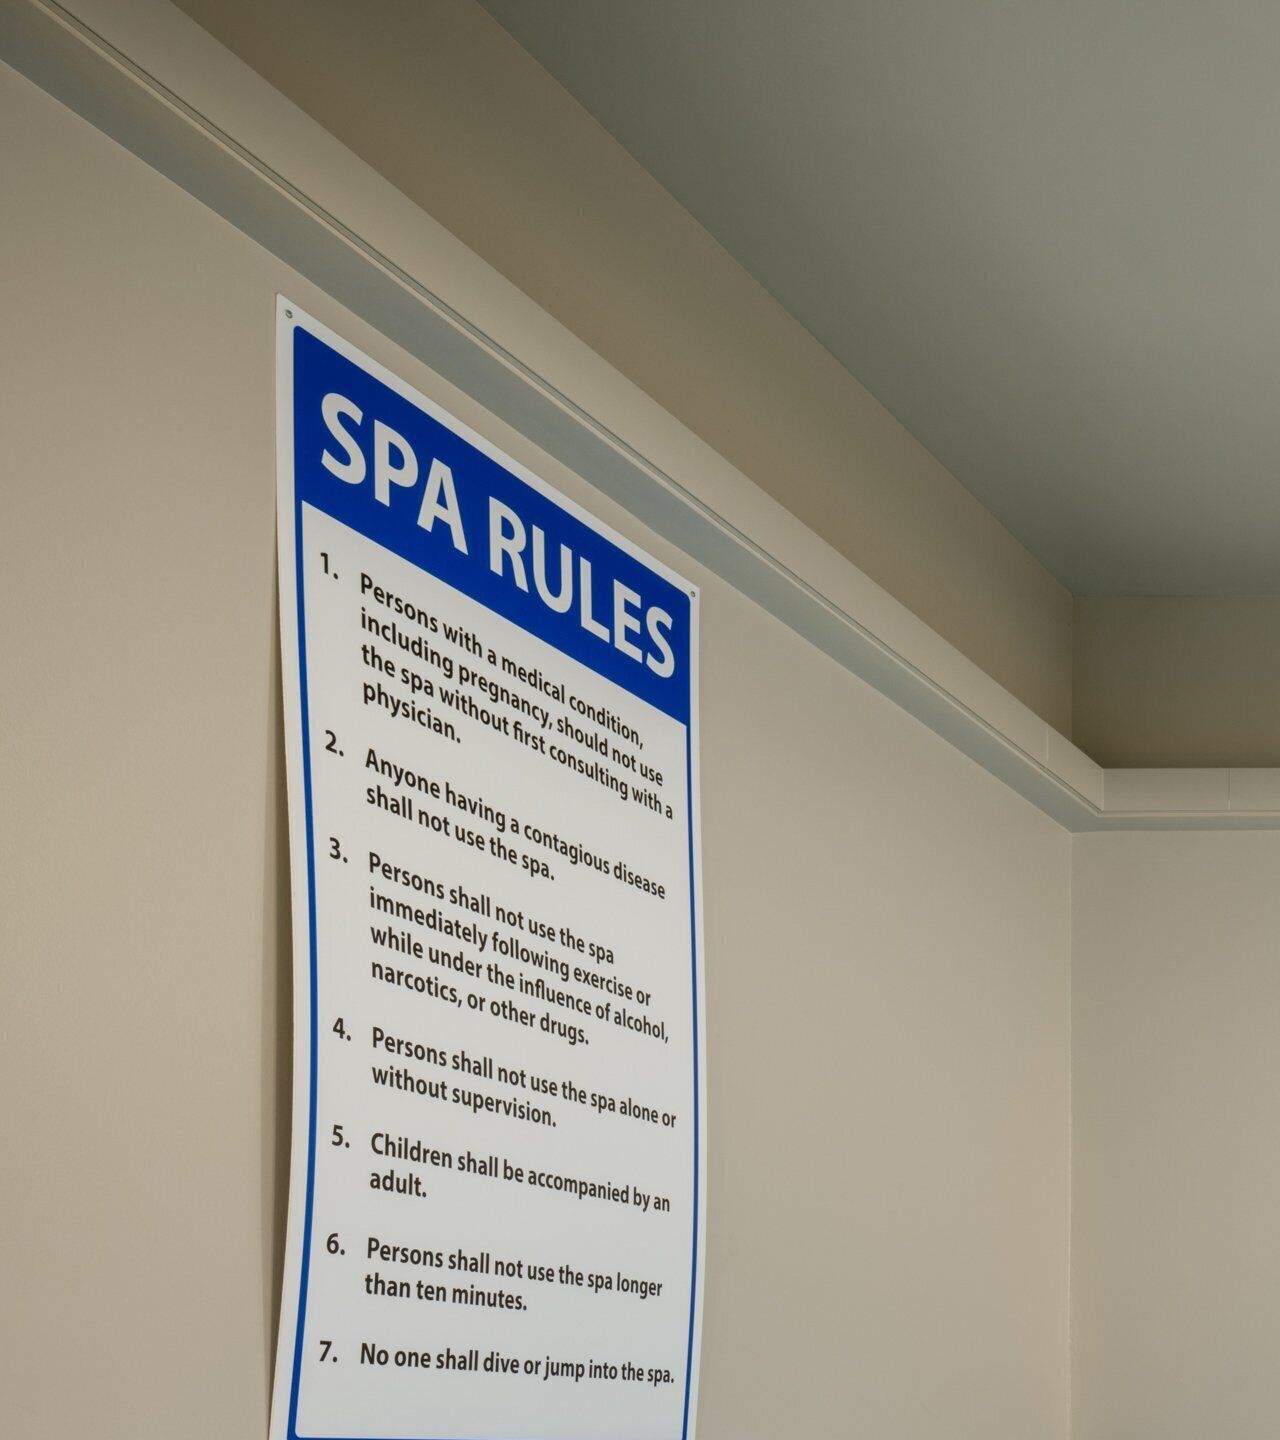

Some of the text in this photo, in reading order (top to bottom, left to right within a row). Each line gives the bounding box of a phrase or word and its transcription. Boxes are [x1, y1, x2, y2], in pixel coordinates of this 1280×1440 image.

[321, 392, 676, 679] SPA RULES
[320, 552, 643, 750] 1. Persons with a medical condition,
[361, 606, 663, 787] including pregnancy, should not use
[361, 644, 673, 820] the spa without first consulting with a
[363, 682, 461, 743] physician.
[325, 730, 665, 899] 2. Anyone having a contagious disease
[367, 785, 554, 881] shall not use the spa.
[330, 837, 614, 964] 3. Persons shall not use the spa
[370, 886, 651, 1006] immediately following exercise or
[370, 926, 668, 1043] while under the influence of alcohol,
[372, 962, 589, 1046] narcotics, or other drugs.
[333, 1017, 676, 1128] 4. Persons shall not use the spa alone or
[372, 1065, 556, 1127] without supervision.
[332, 1124, 670, 1212] 5. Children shall be accompanied by an
[370, 1169, 426, 1198] adult.
[327, 1233, 663, 1300] 6. Persons shall not use the spa longer
[365, 1272, 527, 1311] than ten minutes.
[319, 1340, 674, 1387] 7. No one shall dive or jump into the spa.
